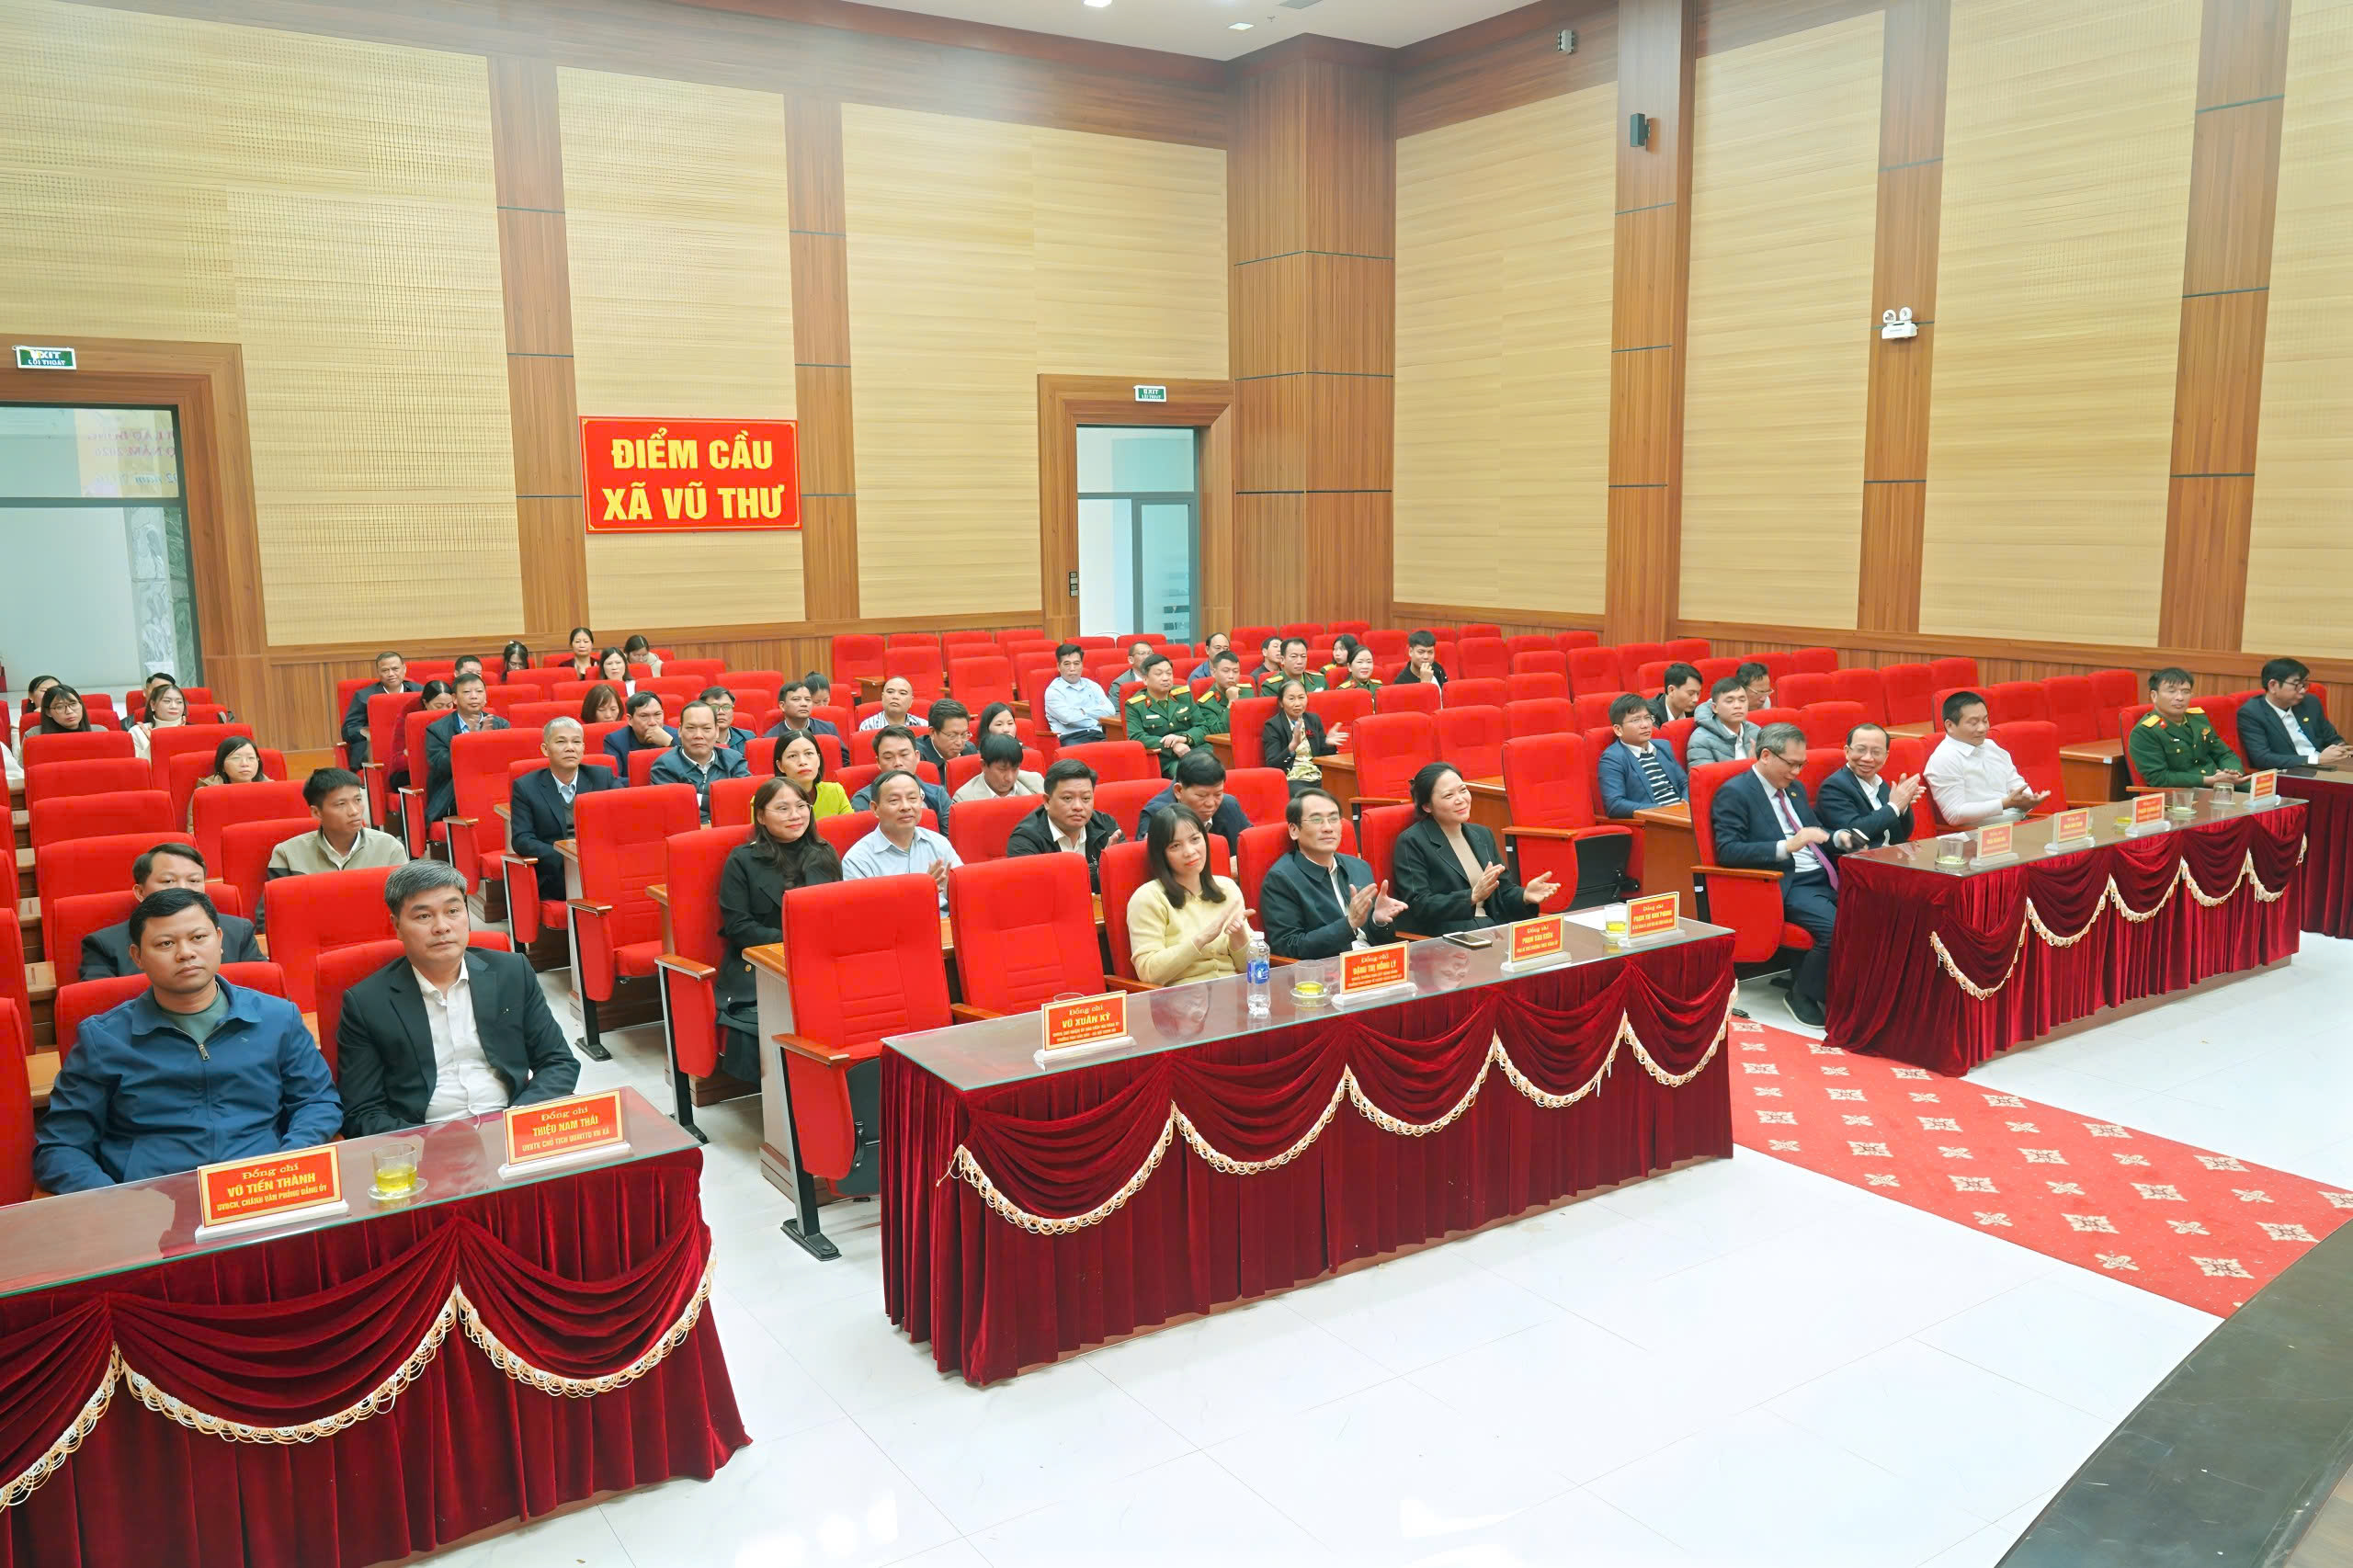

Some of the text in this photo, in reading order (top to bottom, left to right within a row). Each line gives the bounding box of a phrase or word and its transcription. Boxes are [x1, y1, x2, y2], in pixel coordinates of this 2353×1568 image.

[611, 426, 773, 470] ĐIỂM CẦU
[602, 481, 785, 520] XÃ VŨ THƯ
[1075, 1015, 1097, 1026] XUÂN
[1100, 1012, 1110, 1022] KỲ
[541, 1106, 588, 1121] Đồng chí
[532, 1115, 598, 1137] THIỆU NAM THÁI
[242, 1163, 299, 1179] Đồng chí
[227, 1173, 315, 1198] VŨ TIẾN THÀNH
